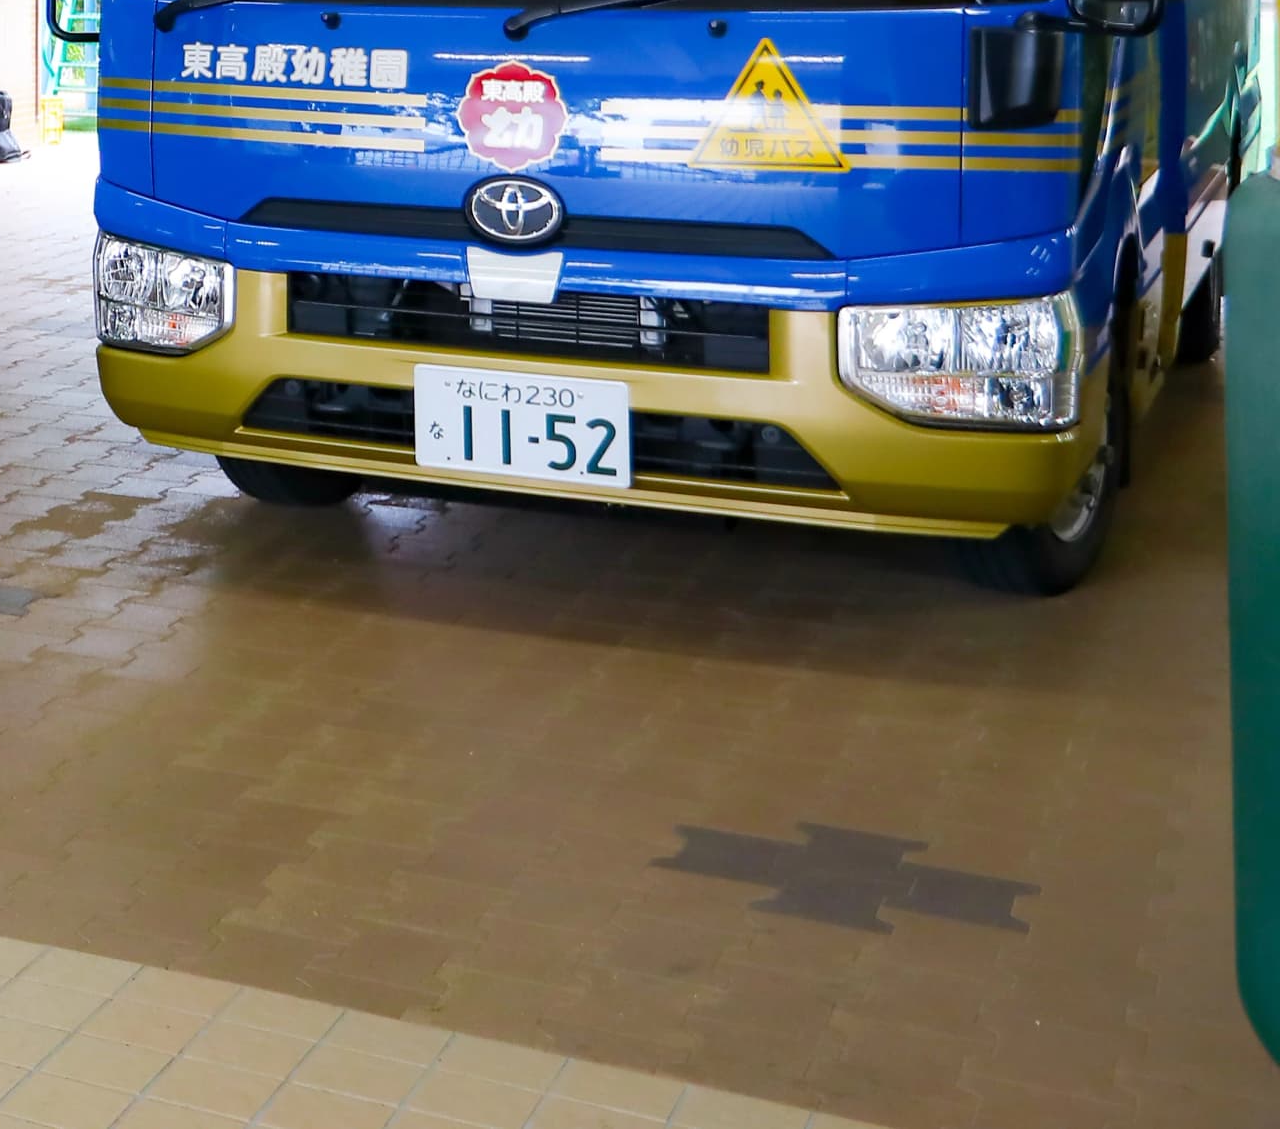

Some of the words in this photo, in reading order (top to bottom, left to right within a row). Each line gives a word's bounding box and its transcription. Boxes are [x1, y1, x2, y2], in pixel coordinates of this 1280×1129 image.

[181, 42, 408, 89] 東高殿幼稚園
[481, 79, 545, 103] 東高殿
[481, 106, 544, 150] 幼
[719, 137, 814, 159] 幼児バス
[429, 421, 444, 439] な
[463, 405, 617, 476] 11-52
